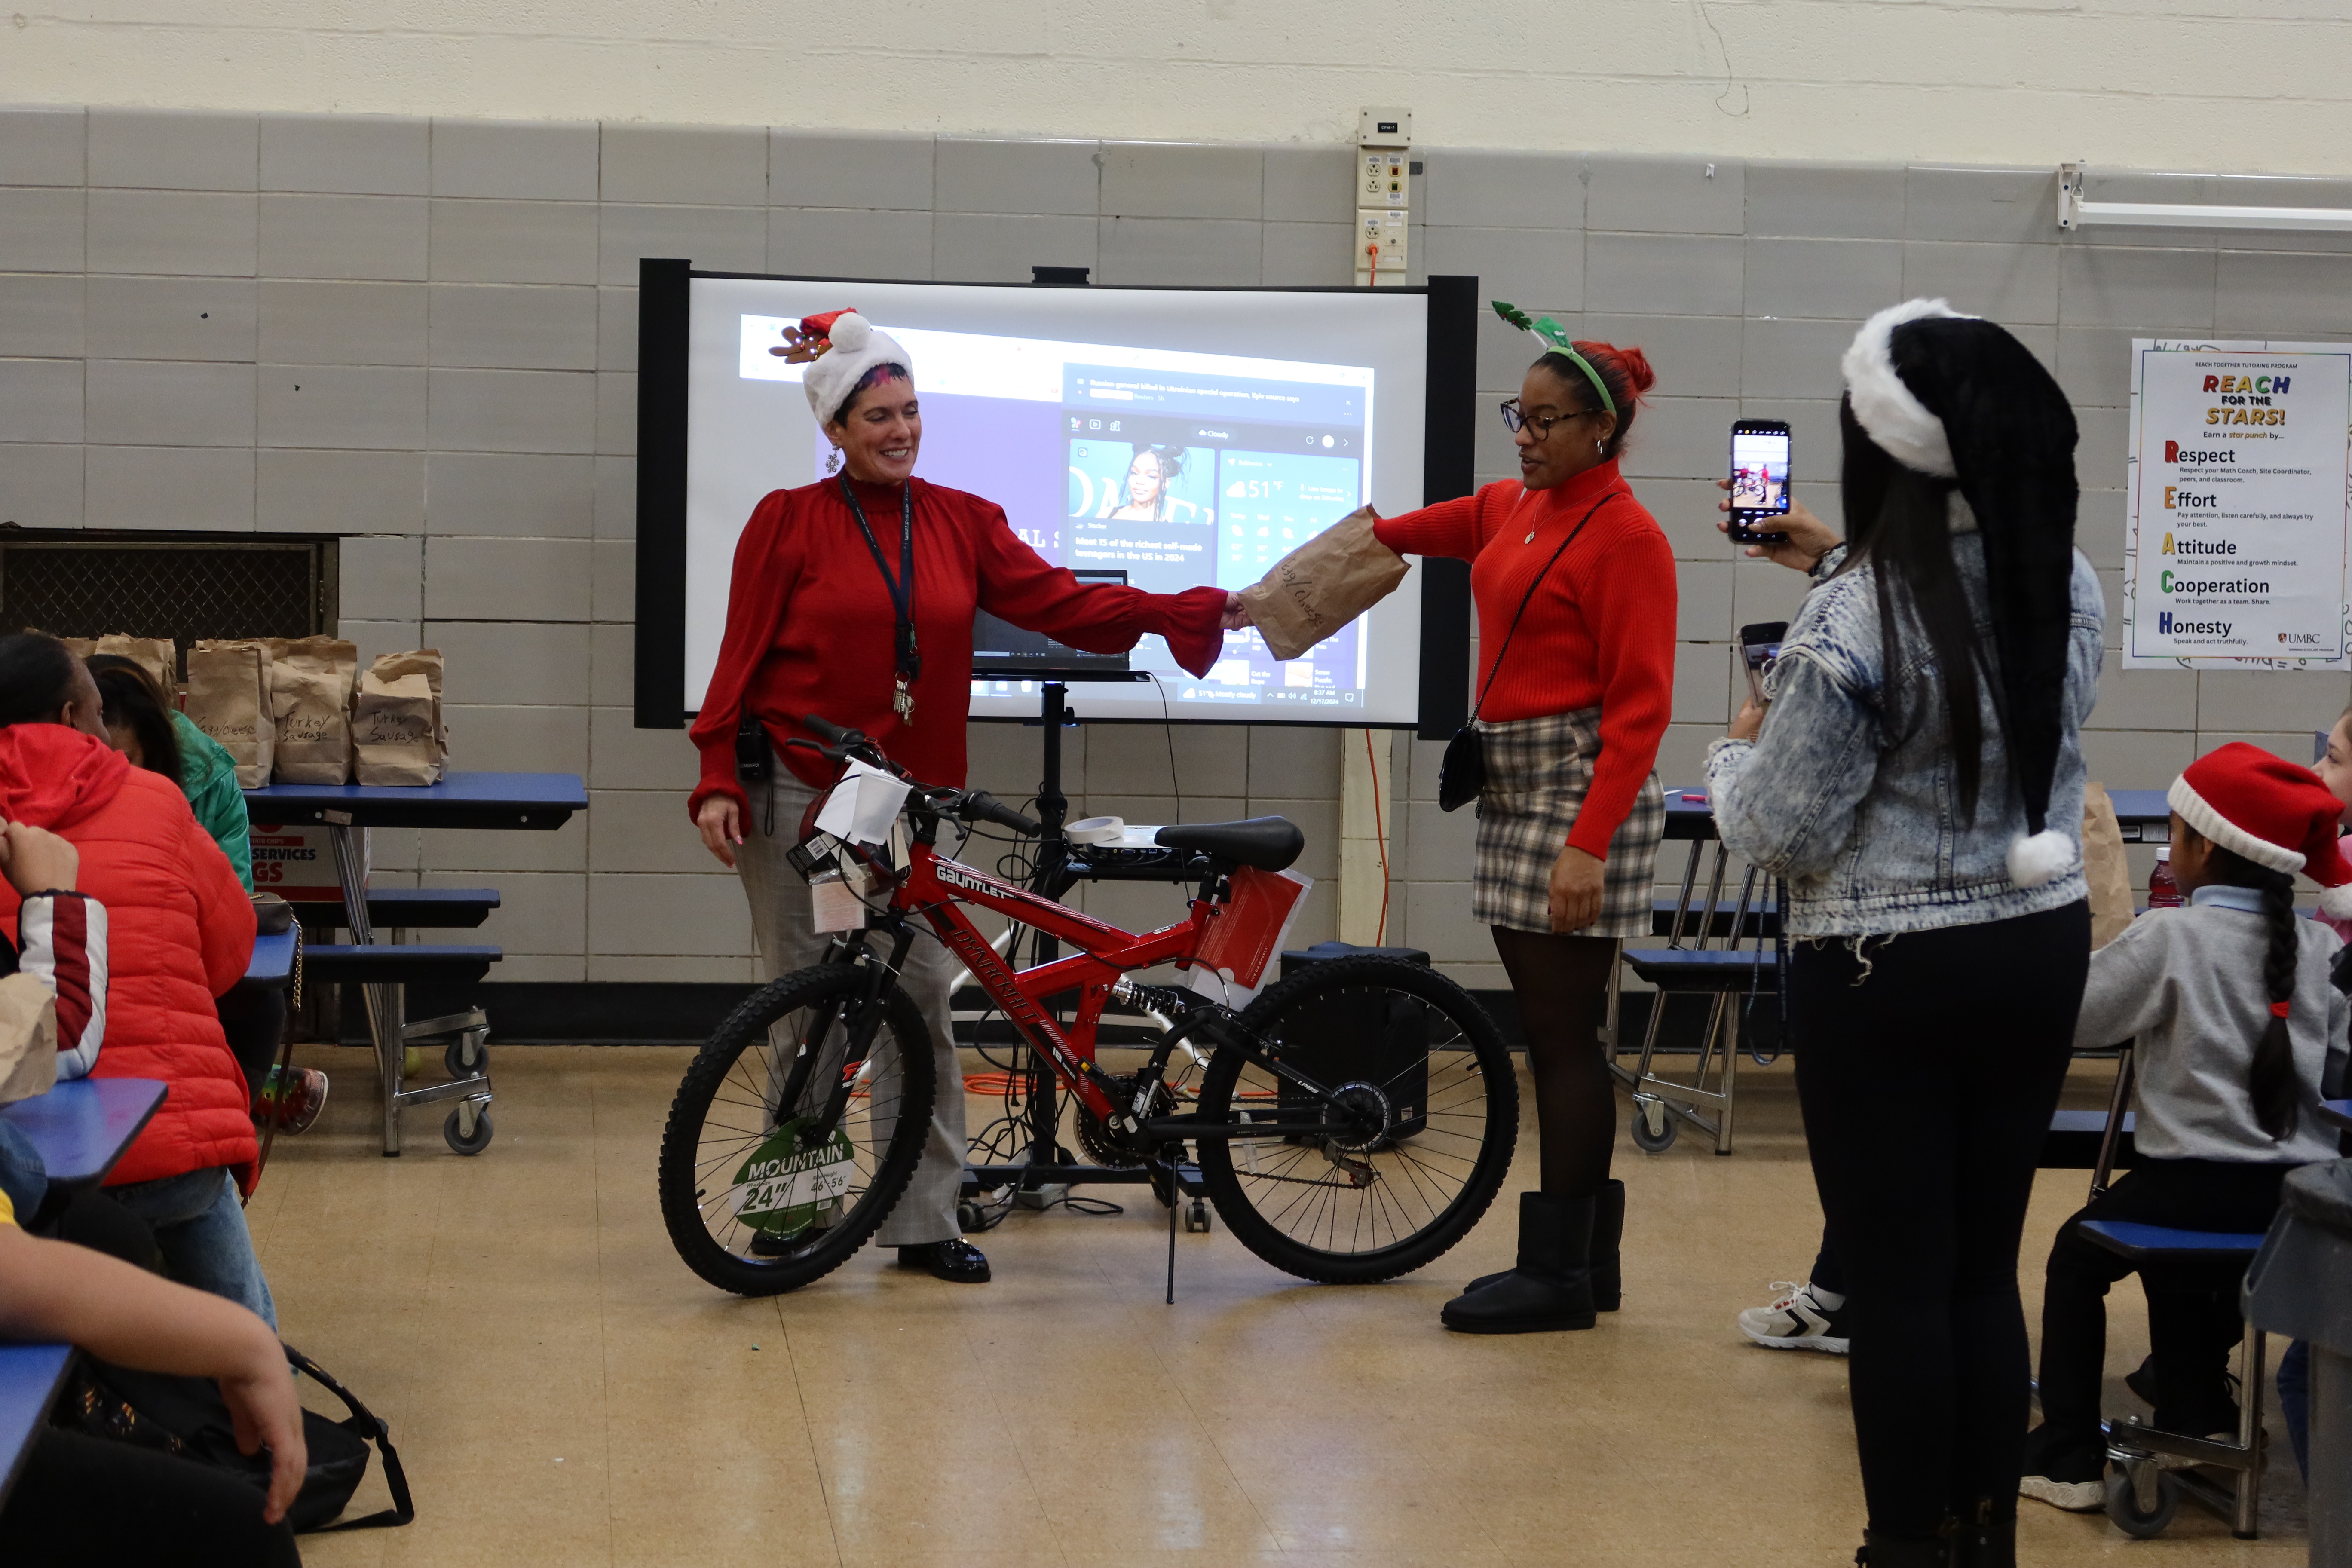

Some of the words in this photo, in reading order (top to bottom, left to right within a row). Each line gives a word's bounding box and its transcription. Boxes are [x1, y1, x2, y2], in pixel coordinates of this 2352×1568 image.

[1090, 379, 1115, 387] Russian
[1115, 381, 1139, 390] general
[1140, 382, 1158, 391] killed
[1166, 385, 1196, 394] Ukrainian
[1197, 387, 1218, 396] special
[1219, 388, 1250, 399] operation,
[1251, 391, 1265, 400] Kyiv
[2202, 374, 2291, 394] REACH
[2221, 396, 2245, 406] FOR
[2250, 396, 2272, 406] THE
[2205, 407, 2286, 425] STARS!
[1207, 430, 1229, 439] Cloudy
[2165, 440, 2235, 466] Respect
[2164, 486, 2217, 509] Effort
[1075, 537, 1097, 547] Meet
[1098, 538, 1108, 546] 15
[1109, 539, 1118, 547] of
[1119, 539, 1134, 548] the
[1135, 540, 1162, 549] richest
[1163, 541, 1203, 551] self-made
[2162, 532, 2236, 555] Attitude
[1075, 549, 1116, 560] teenagers
[1117, 550, 1125, 559] in
[1126, 551, 1140, 560] the
[1141, 552, 1154, 560] US
[1155, 553, 1163, 561] in
[1164, 554, 1185, 562] 2024
[2248, 559, 2270, 567] growth
[2161, 570, 2269, 596] Cooperation
[2159, 611, 2232, 637] Honesty
[2217, 638, 2248, 646] truthfully.
[2288, 634, 2320, 644] UMBC
[1215, 691, 1236, 699] Mostly
[1236, 691, 1256, 700] cloudy
[284, 710, 330, 730] Turkey
[366, 711, 410, 727] Turkey
[283, 730, 328, 743] Sausage
[370, 726, 419, 744] Sausage
[252, 848, 316, 861] SERVICES
[252, 861, 283, 882] GS
[952, 929, 1041, 1023] DYNACRAFT
[747, 1142, 844, 1181] MOUNTAIN
